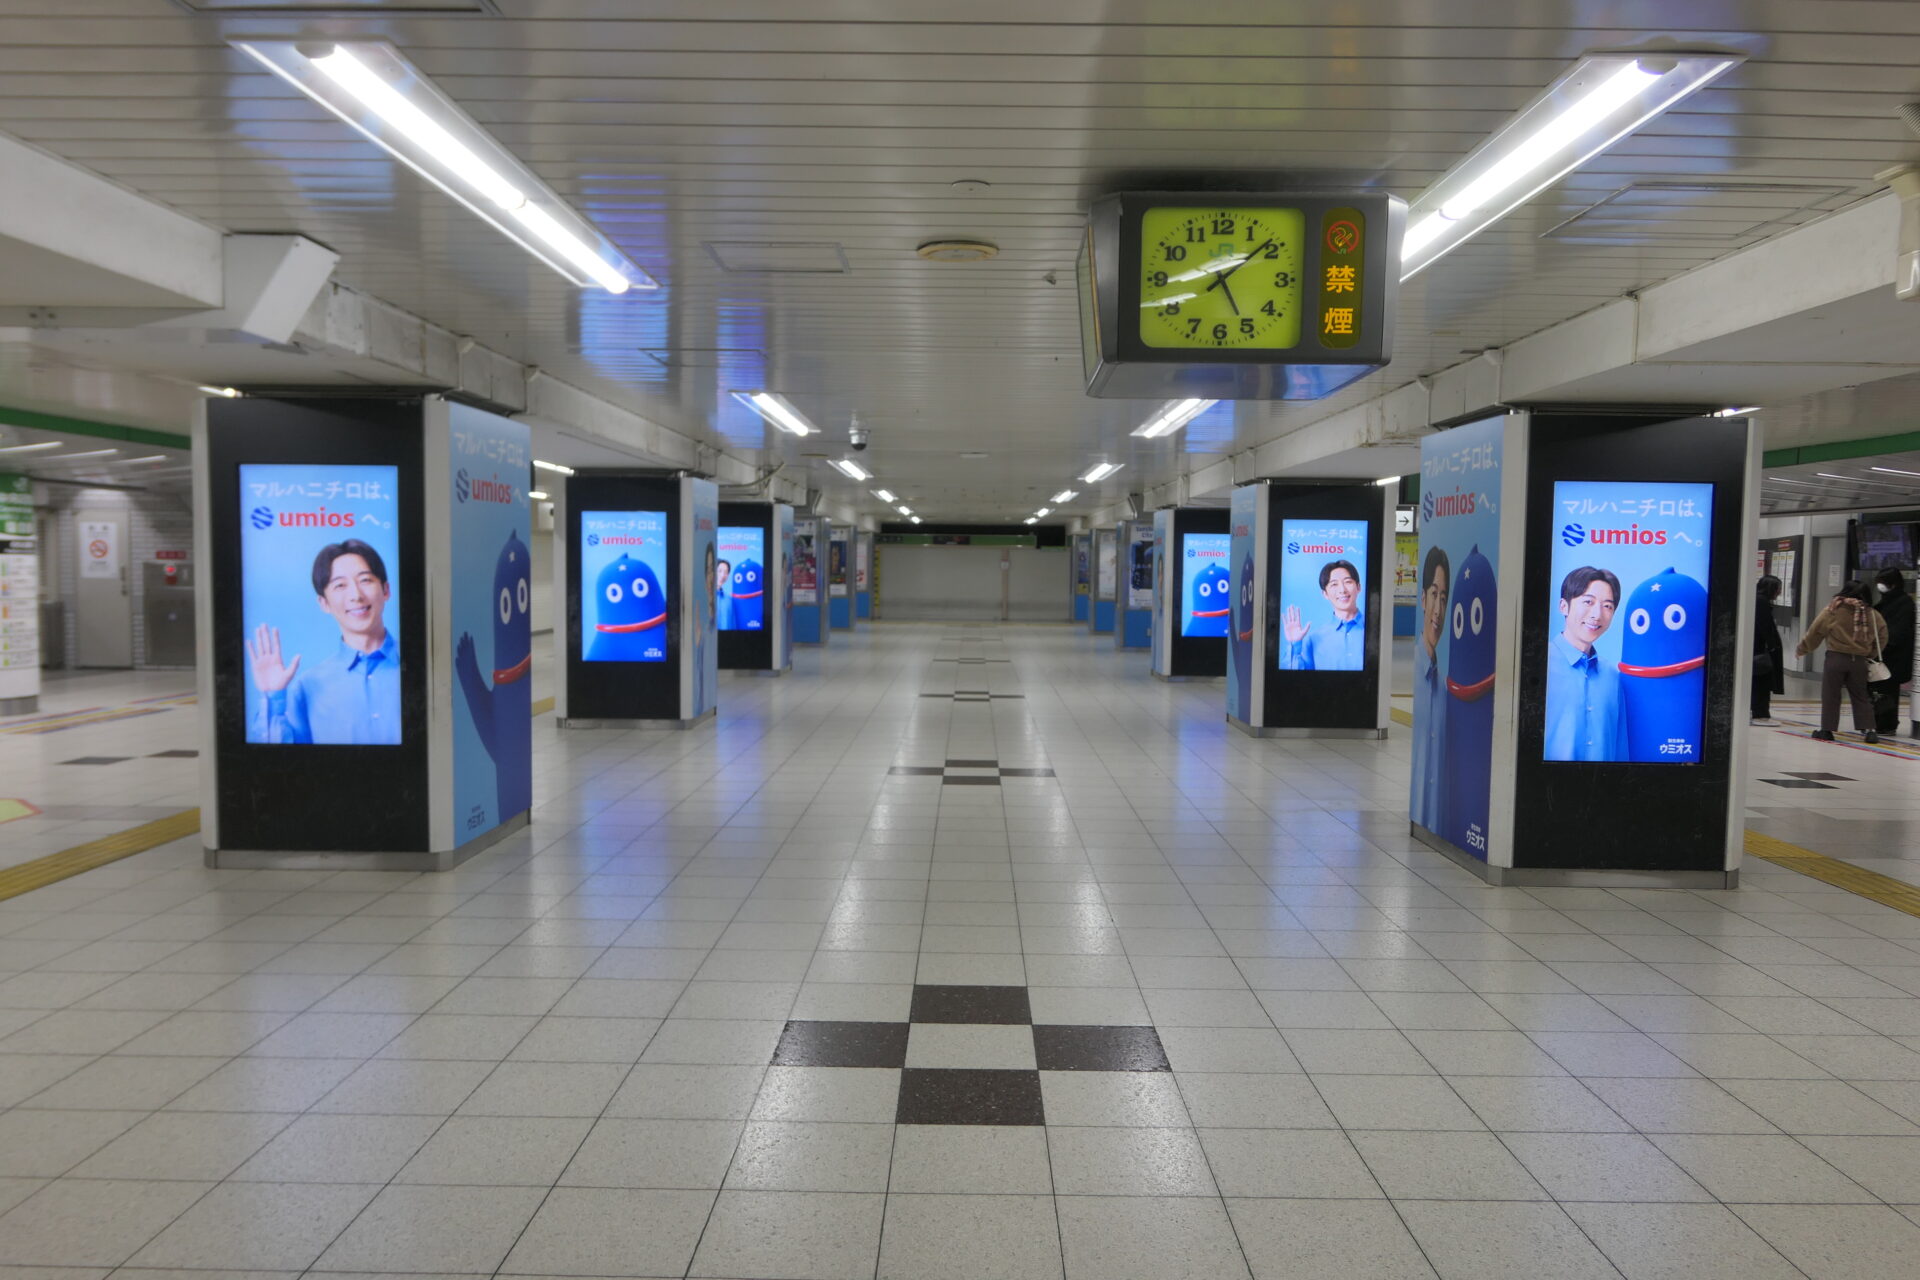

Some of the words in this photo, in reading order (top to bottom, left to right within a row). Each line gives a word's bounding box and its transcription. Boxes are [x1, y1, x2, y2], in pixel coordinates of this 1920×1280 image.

[1185, 226, 1206, 243] 11
[1211, 219, 1235, 235] 12
[1246, 226, 1255, 241] 1
[1164, 245, 1187, 261] 10
[1209, 242, 1234, 258] JR
[1263, 243, 1280, 260] 2
[1153, 271, 1169, 288] 9
[1274, 271, 1290, 288] 3
[1165, 300, 1180, 316] 8
[1260, 299, 1277, 316] 4
[1324, 264, 1356, 335] 禁煙
[1187, 318, 1202, 335] 7
[1212, 323, 1228, 340] 6
[1239, 318, 1255, 334] 5
[248, 480, 391, 501] マルハニチロは、
[472, 472, 513, 505] umios
[1435, 485, 1476, 517] umios
[1562, 498, 1705, 518] マルハニチロは、
[278, 506, 356, 528] umios
[361, 513, 392, 530] へ。
[602, 534, 644, 546] umios
[1590, 523, 1668, 545] umios
[1673, 531, 1704, 547] へ。
[1197, 549, 1226, 558] umios
[1302, 541, 1345, 554] umios
[1659, 743, 1693, 754] ウミオス
